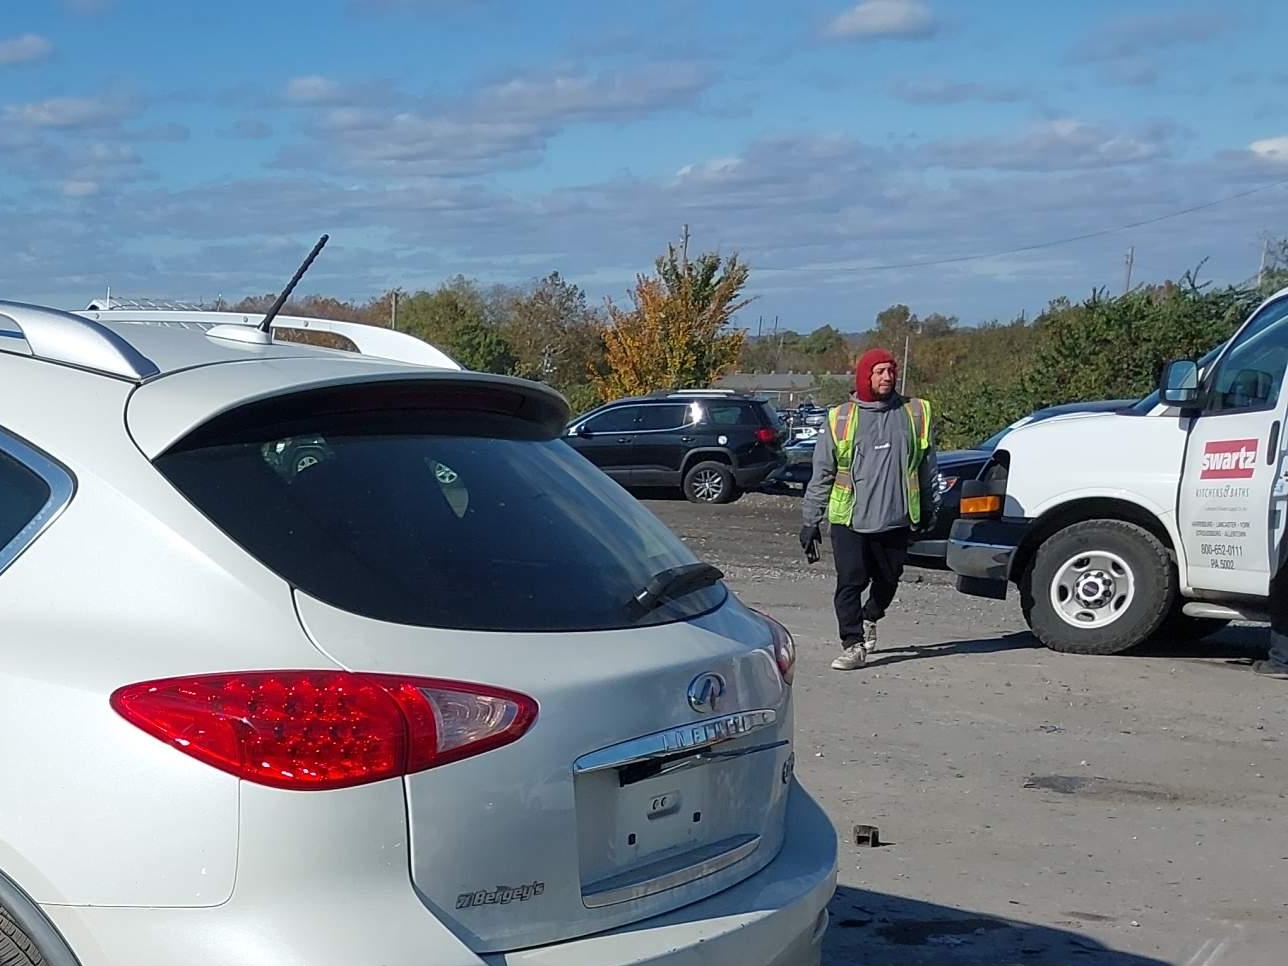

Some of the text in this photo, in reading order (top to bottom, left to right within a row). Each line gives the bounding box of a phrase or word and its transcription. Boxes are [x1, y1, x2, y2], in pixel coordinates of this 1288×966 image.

[1201, 446, 1256, 470] swartz
[1231, 487, 1249, 497] BATHS
[1201, 543, 1243, 557] 800-652-0111
